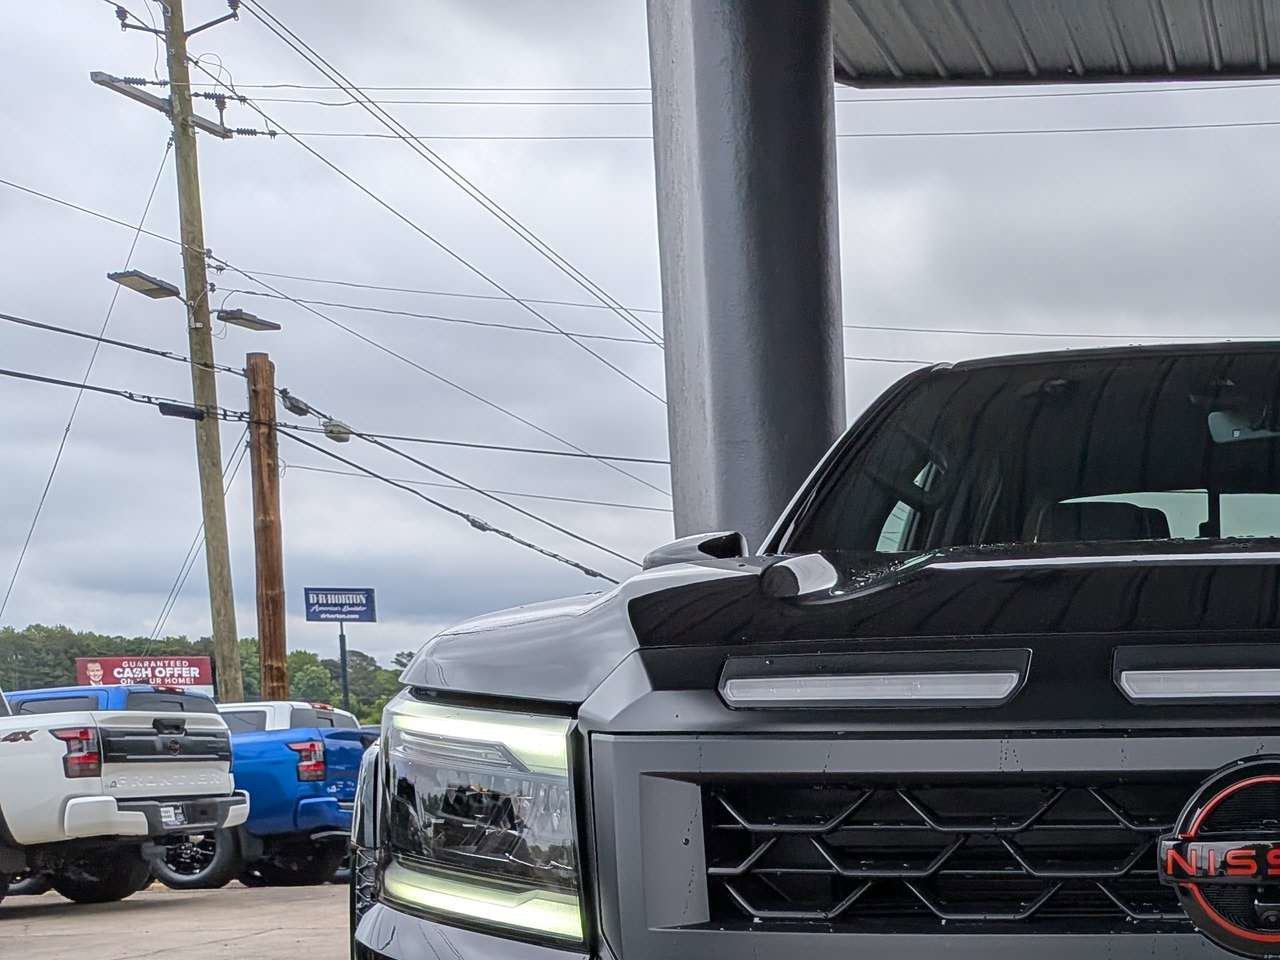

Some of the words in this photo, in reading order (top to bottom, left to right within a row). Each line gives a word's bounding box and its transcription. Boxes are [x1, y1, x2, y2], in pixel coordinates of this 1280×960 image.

[122, 660, 189, 668] GUARANTEED
[113, 667, 152, 678] CASH
[155, 667, 200, 678] OFFER
